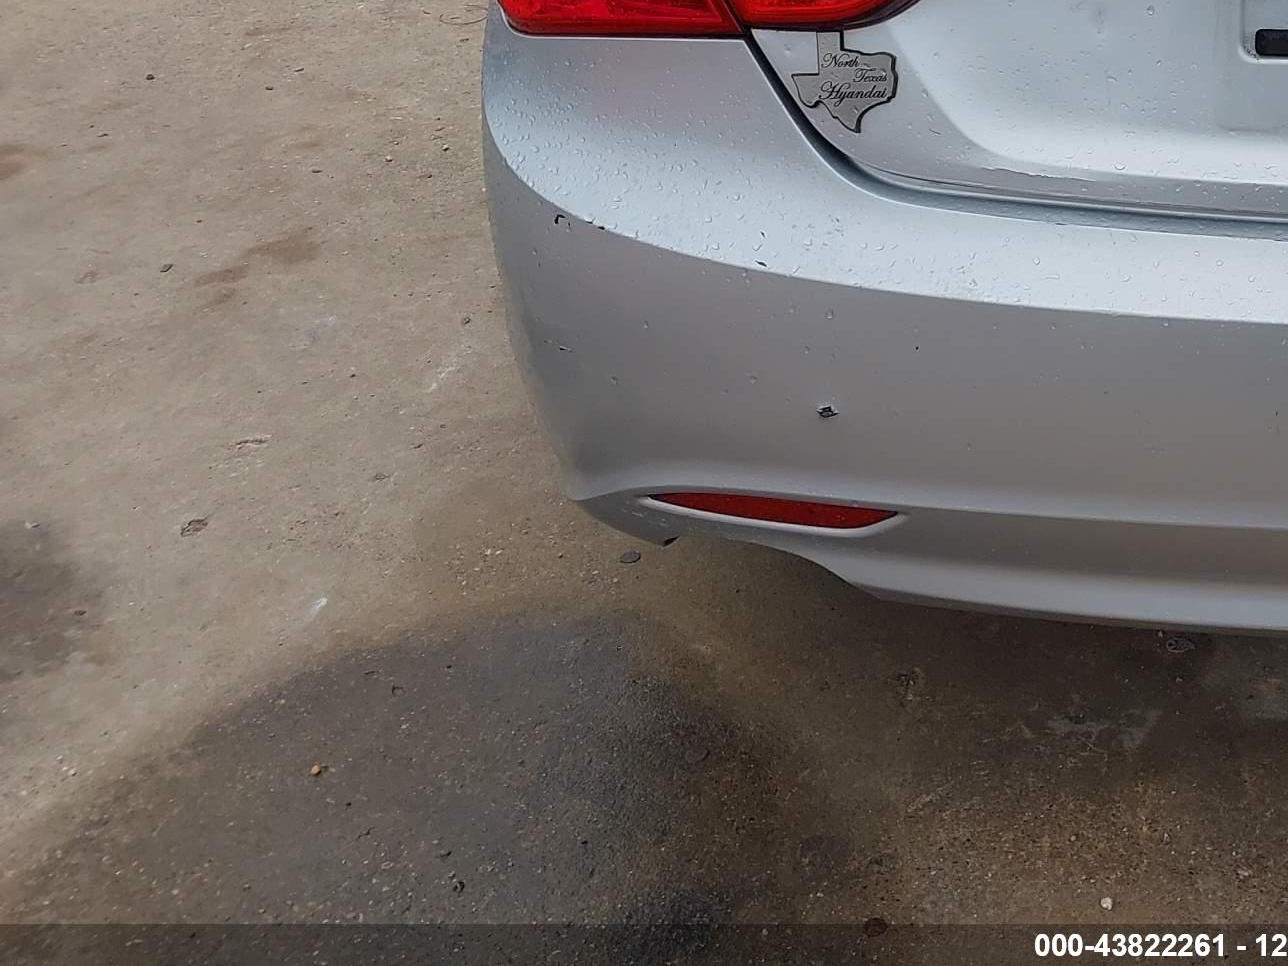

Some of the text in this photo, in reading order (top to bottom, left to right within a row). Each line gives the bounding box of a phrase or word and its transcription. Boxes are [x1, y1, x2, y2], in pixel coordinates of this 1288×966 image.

[821, 52, 859, 68] North
[853, 67, 888, 83] Texas
[818, 80, 888, 107] Hyundai
